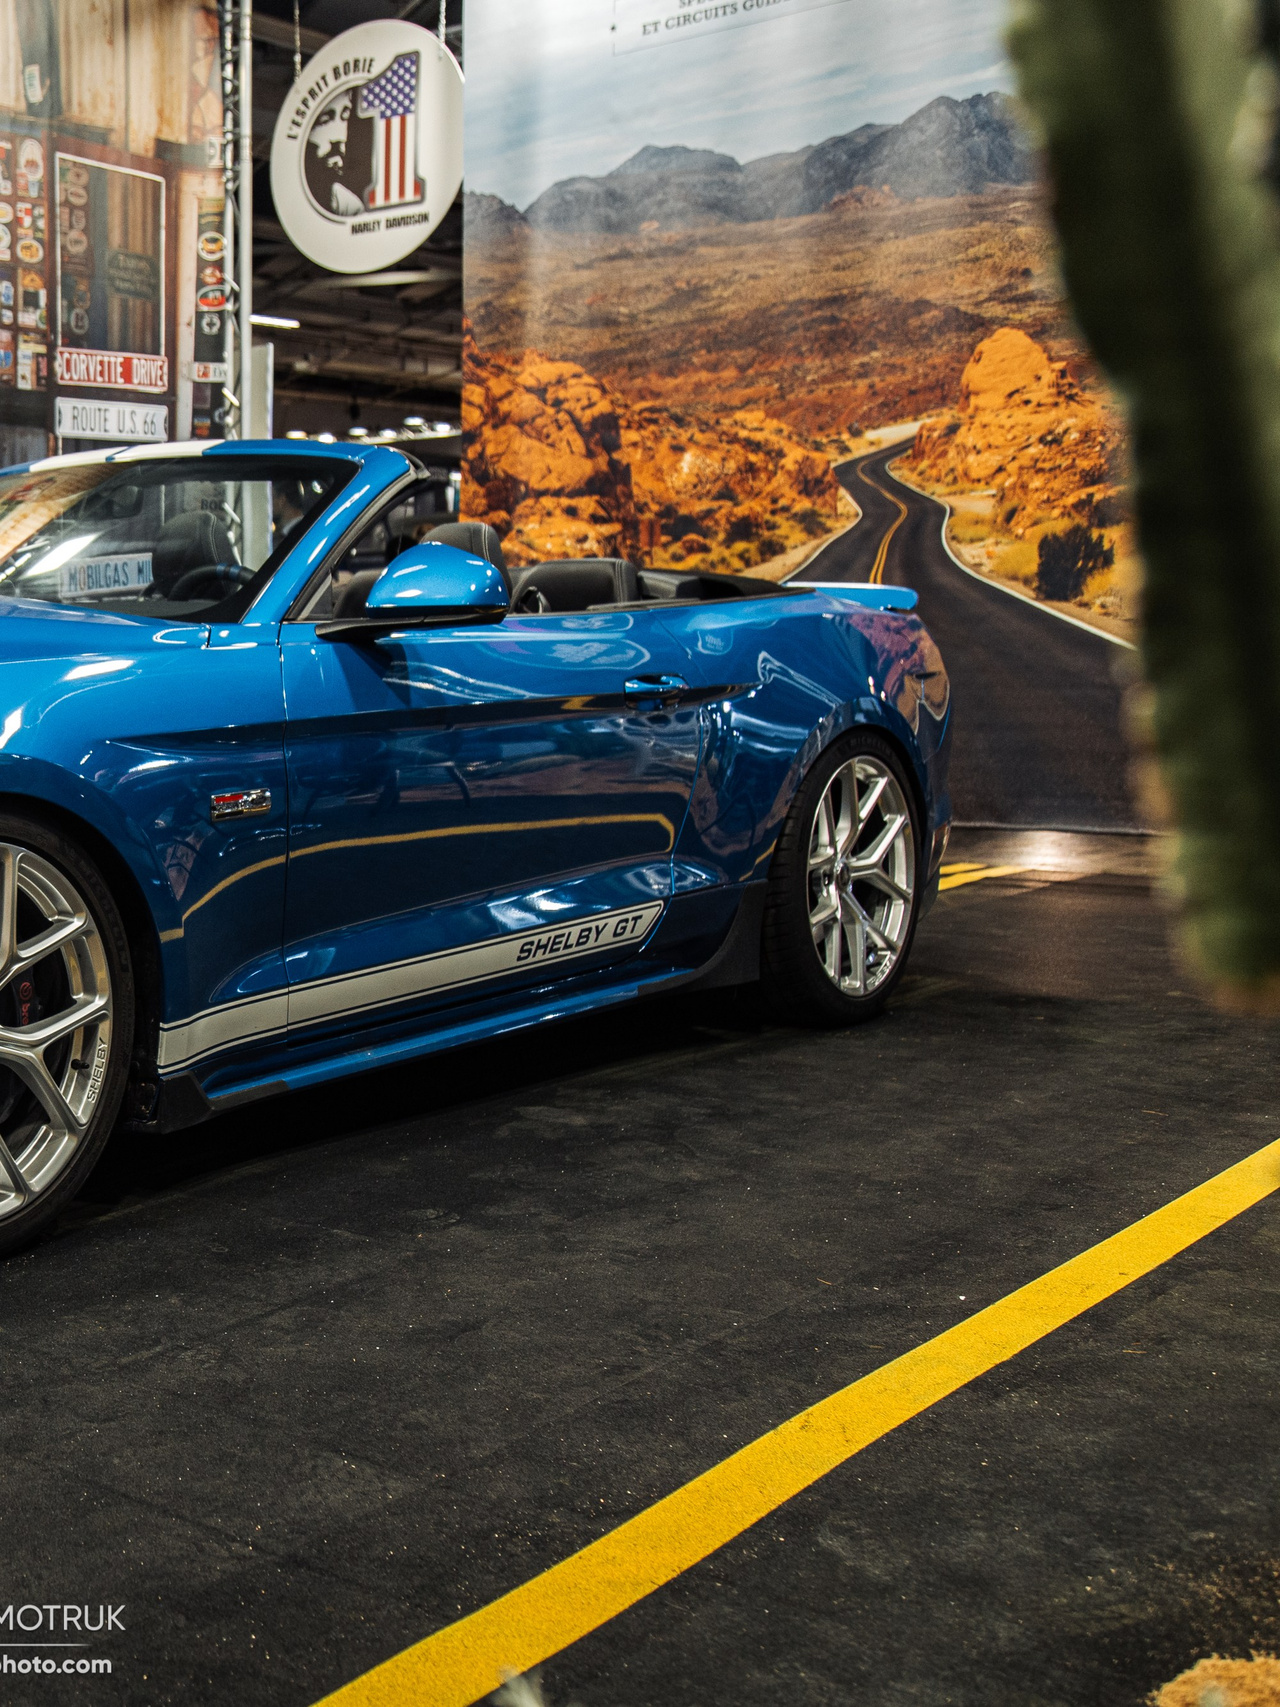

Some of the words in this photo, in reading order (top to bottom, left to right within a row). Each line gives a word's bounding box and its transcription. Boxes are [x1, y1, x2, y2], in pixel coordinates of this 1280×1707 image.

[642, 21, 660, 36] ET
[665, 6, 738, 29] CIRCUITS
[286, 77, 330, 141] L'ESPRIT
[333, 58, 376, 81] BORIE
[351, 222, 382, 236] HARLEY
[386, 212, 431, 229] DAVIDSON
[62, 352, 125, 384] CORVETTE
[132, 358, 163, 387] DRIVE
[72, 405, 110, 434] ROUTE
[118, 408, 140, 435] U.S.
[143, 412, 157, 436] 66
[68, 560, 130, 593] MOBILGAS
[516, 922, 609, 962] SHELBY
[613, 914, 644, 939] GT
[86, 1036, 108, 1104] SHELBY
